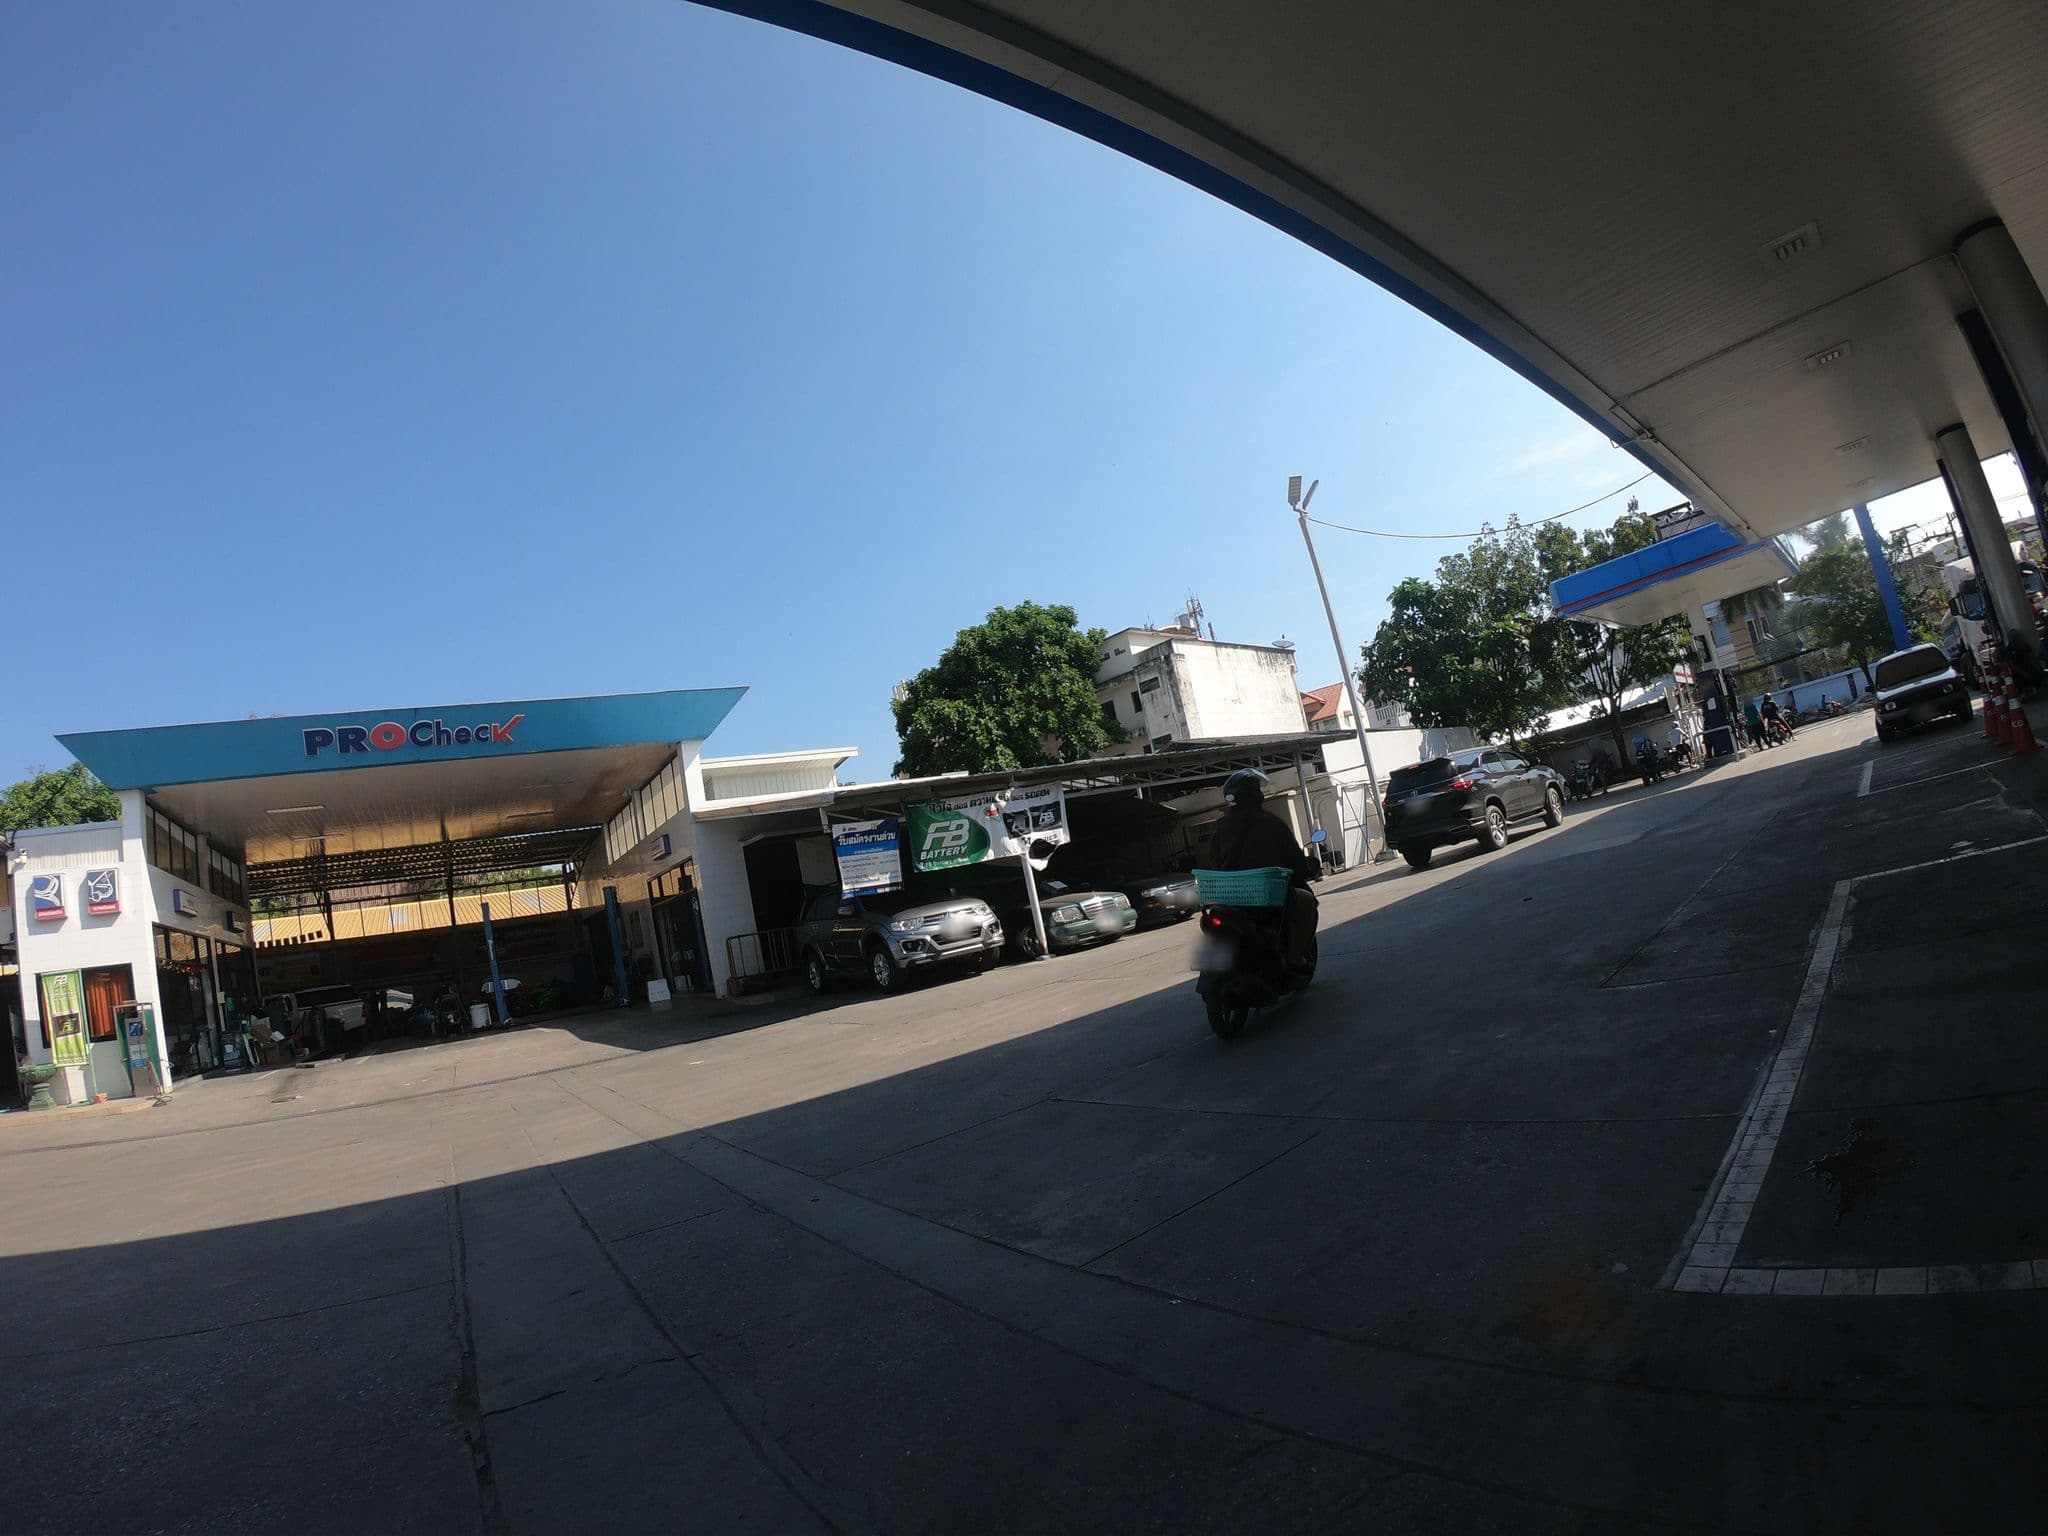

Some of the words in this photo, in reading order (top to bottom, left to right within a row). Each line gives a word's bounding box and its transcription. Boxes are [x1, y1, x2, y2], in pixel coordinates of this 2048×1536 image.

[838, 830, 896, 846] รับสมัครงานด่วน
[922, 818, 970, 851] FB
[920, 845, 969, 861] BATTERY
[54, 974, 69, 987] FB
